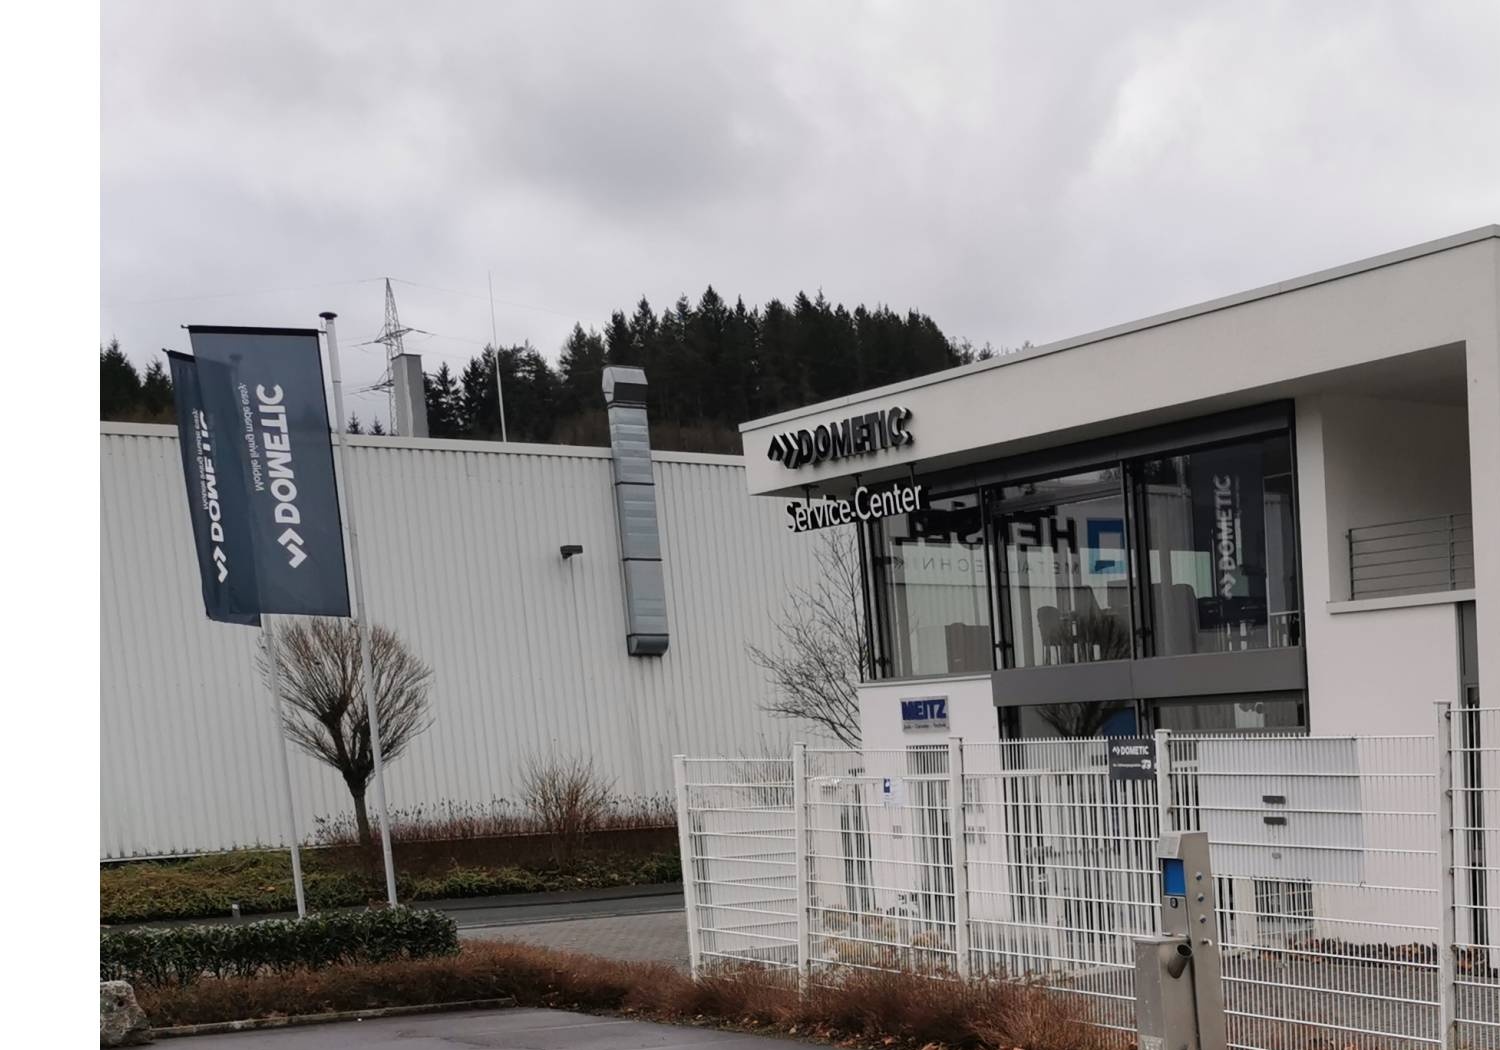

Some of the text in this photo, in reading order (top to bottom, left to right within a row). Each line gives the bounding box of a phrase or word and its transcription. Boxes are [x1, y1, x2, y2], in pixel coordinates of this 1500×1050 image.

[798, 406, 914, 465] DOMETIC
[786, 483, 922, 532] Service Center
[1213, 474, 1236, 570] DOMETIC
[901, 699, 947, 721] MEITZ
